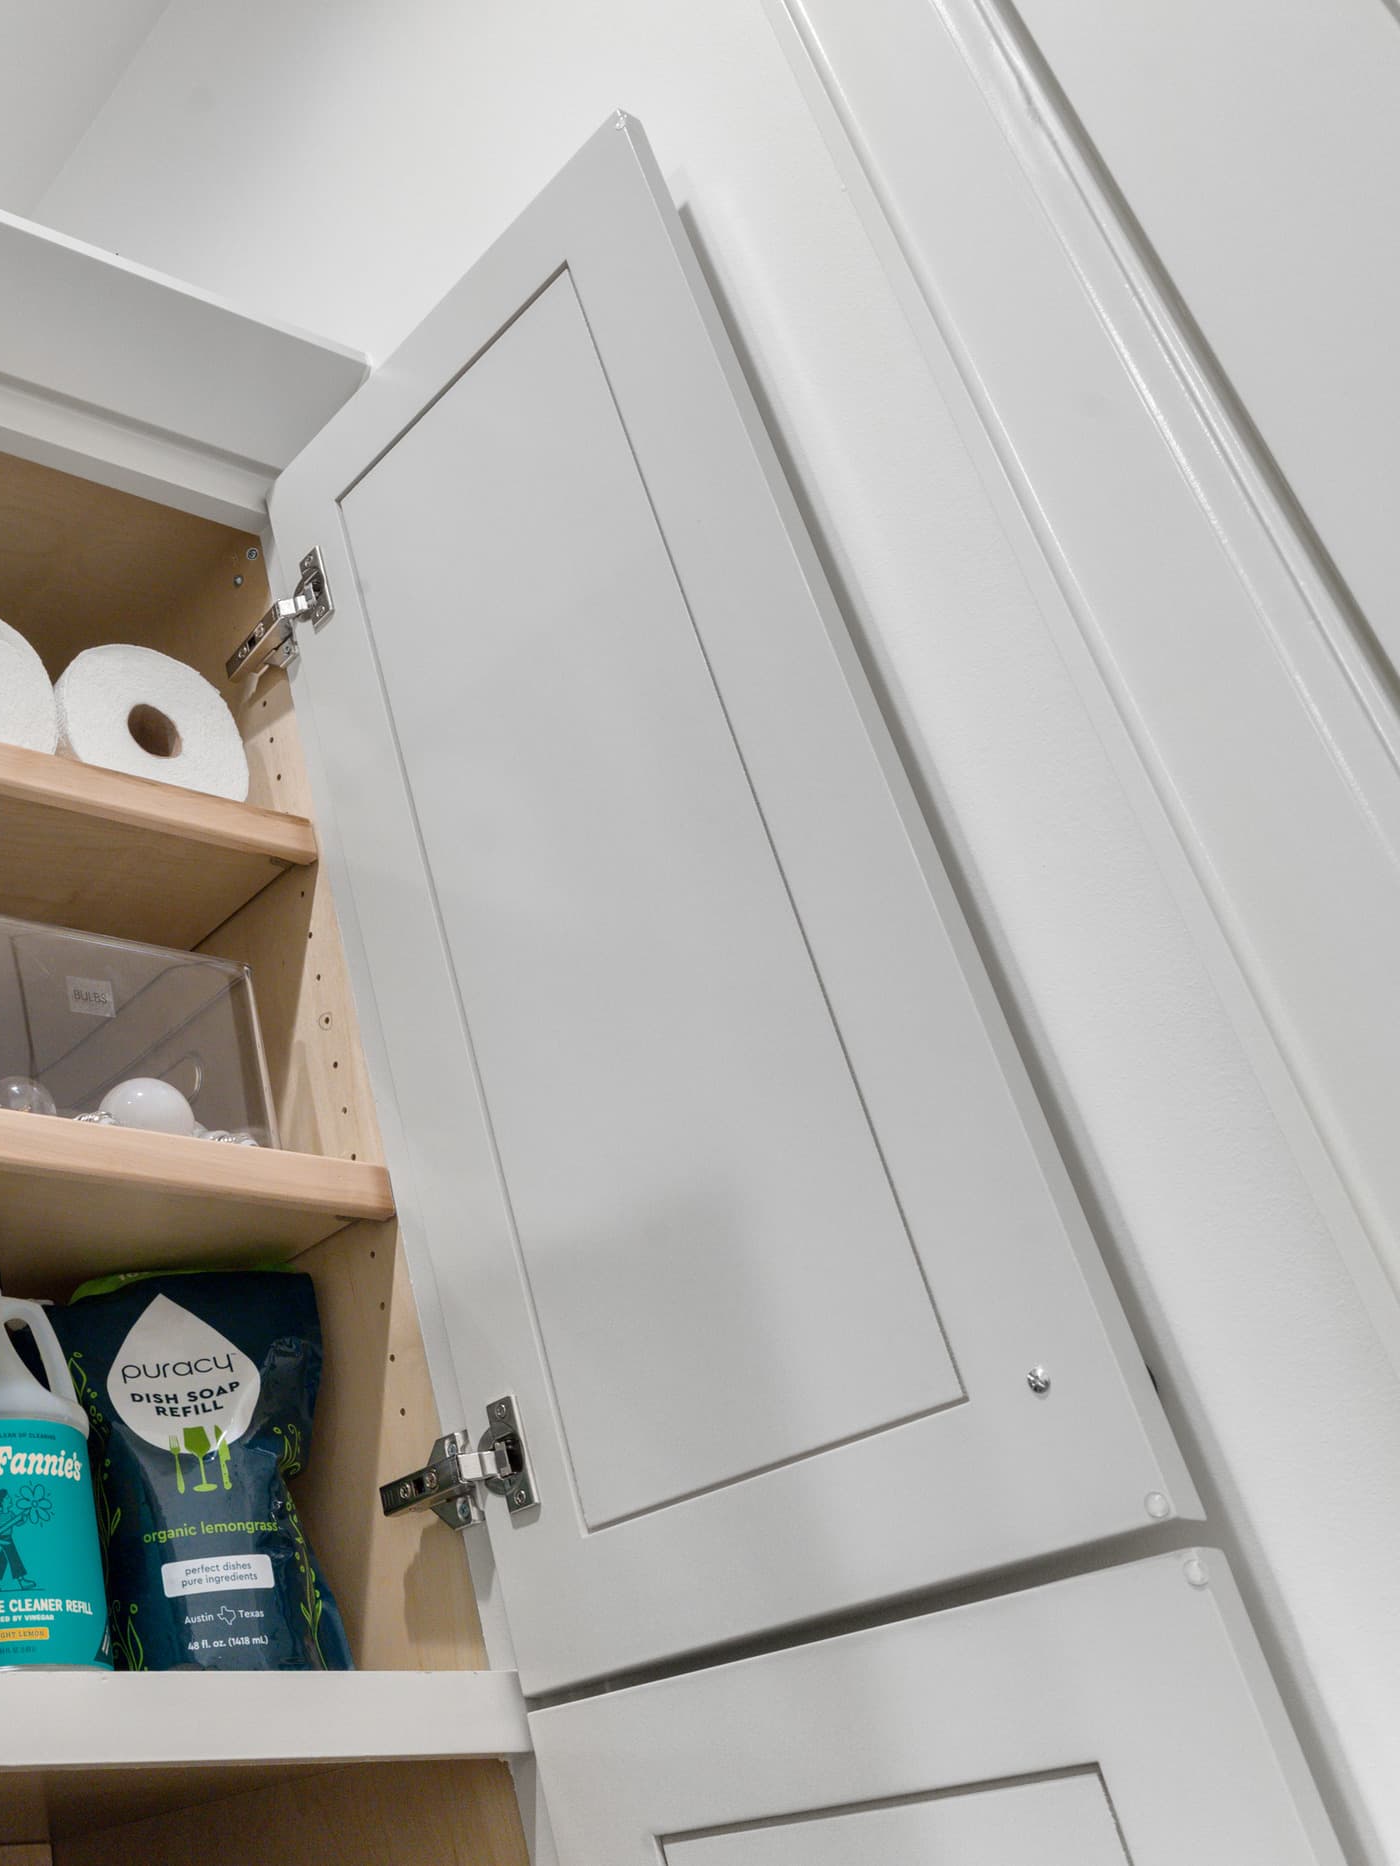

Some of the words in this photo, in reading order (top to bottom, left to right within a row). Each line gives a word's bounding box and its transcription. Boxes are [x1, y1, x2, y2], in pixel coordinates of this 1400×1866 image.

[73, 989, 107, 1004] BULBS
[122, 1353, 234, 1384] puracy
[131, 1393, 179, 1404] DISH
[187, 1381, 240, 1402] SOAP
[155, 1400, 223, 1417] REFILL
[143, 1523, 197, 1543] organic
[201, 1521, 278, 1534] lemongrass
[185, 1564, 220, 1576] perfect
[222, 1561, 251, 1571] dishes
[181, 1577, 203, 1588] pure
[205, 1572, 258, 1584] ingredients
[9, 1598, 63, 1612] CLEANER
[66, 1599, 93, 1615] REFILL
[12, 1614, 22, 1622] BY
[185, 1613, 214, 1624] Austin
[238, 1609, 264, 1618] Texas
[18, 1630, 45, 1638] LEMON
[187, 1641, 200, 1651] 48
[201, 1640, 210, 1649] fl.
[213, 1640, 226, 1648] oz.
[228, 1637, 250, 1648] (1418
[252, 1635, 269, 1646] mL)
